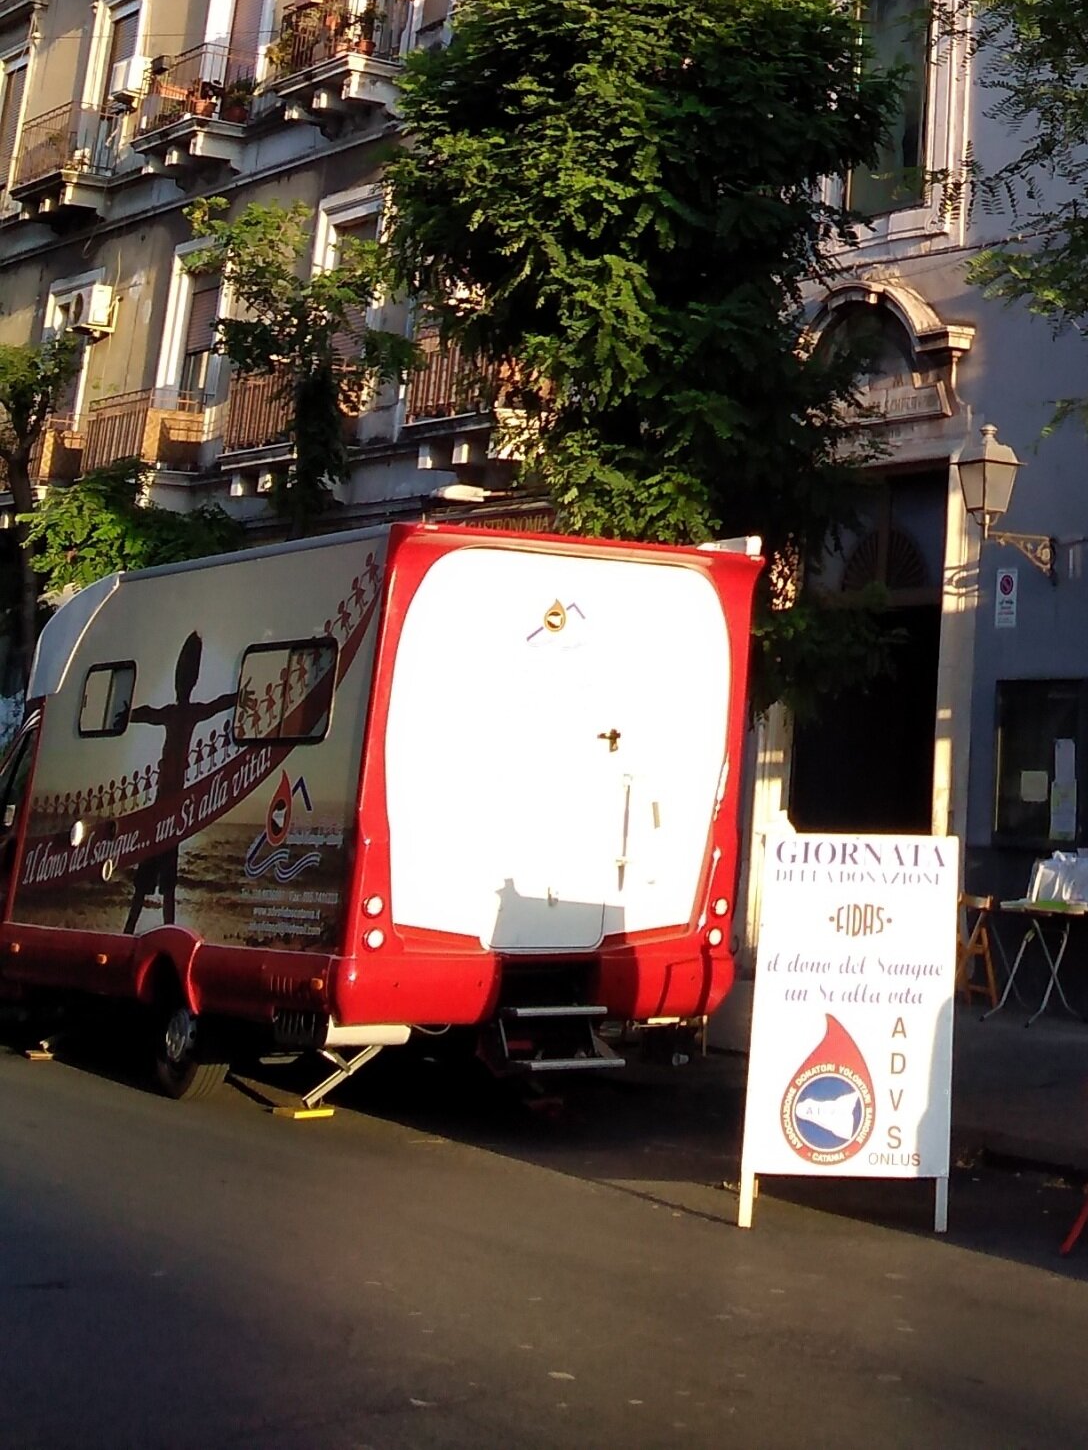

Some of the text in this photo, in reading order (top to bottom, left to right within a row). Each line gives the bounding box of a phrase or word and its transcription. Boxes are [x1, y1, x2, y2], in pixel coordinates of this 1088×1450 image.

[22, 844, 38, 885] Il
[36, 842, 70, 882] dono
[69, 831, 94, 873] del
[155, 819, 176, 843] un
[198, 772, 229, 822] alla
[232, 746, 272, 799] vita!
[776, 840, 945, 868] GIORNATA
[776, 869, 833, 883] DELLA
[836, 904, 885, 937] FIDAS
[787, 953, 831, 973] dono
[839, 955, 866, 974] del
[785, 989, 808, 1002] un
[842, 983, 881, 1004] alla
[888, 987, 923, 1004] vita
[783, 1087, 804, 1150] ASSOCIAZIONE
[795, 1063, 836, 1086] DONATORI
[811, 1152, 846, 1163] CATANIA
[868, 1152, 921, 1167] ONLUS
